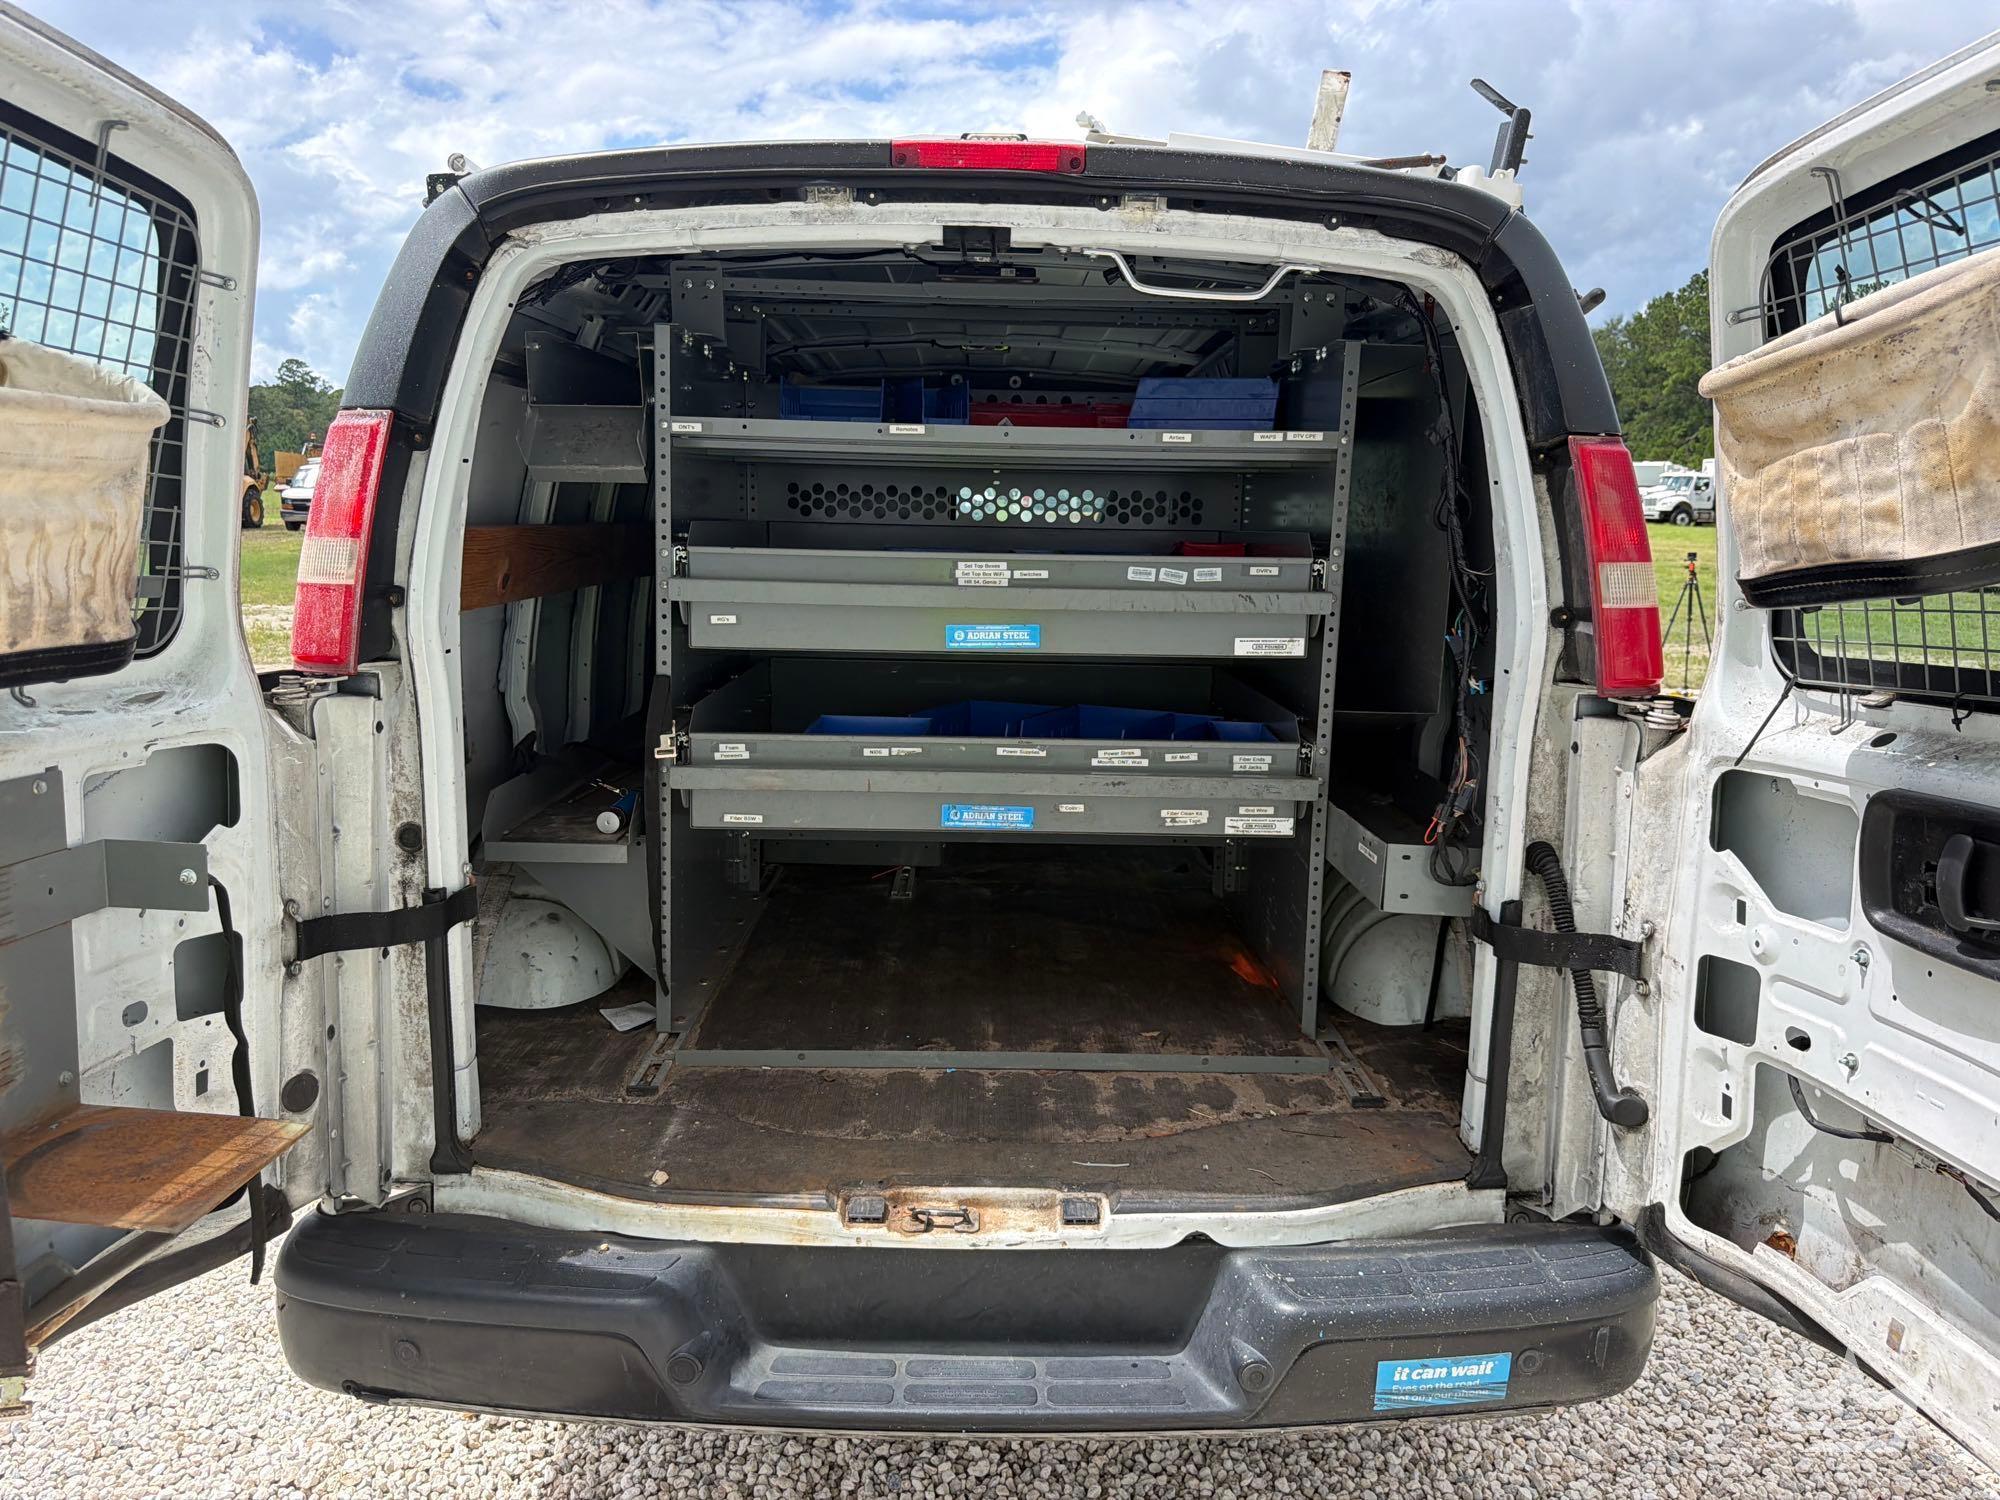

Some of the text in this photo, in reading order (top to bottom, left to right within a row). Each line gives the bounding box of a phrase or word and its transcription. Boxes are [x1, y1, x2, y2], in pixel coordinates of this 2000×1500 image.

[967, 631, 1030, 640] ADRIAN STEEL
[962, 812, 1024, 821] ADRIAN STEEL
[1393, 1361, 1495, 1381] it can wait
[1392, 1379, 1480, 1394] Eyes on the road
[1427, 1391, 1454, 1403] your
